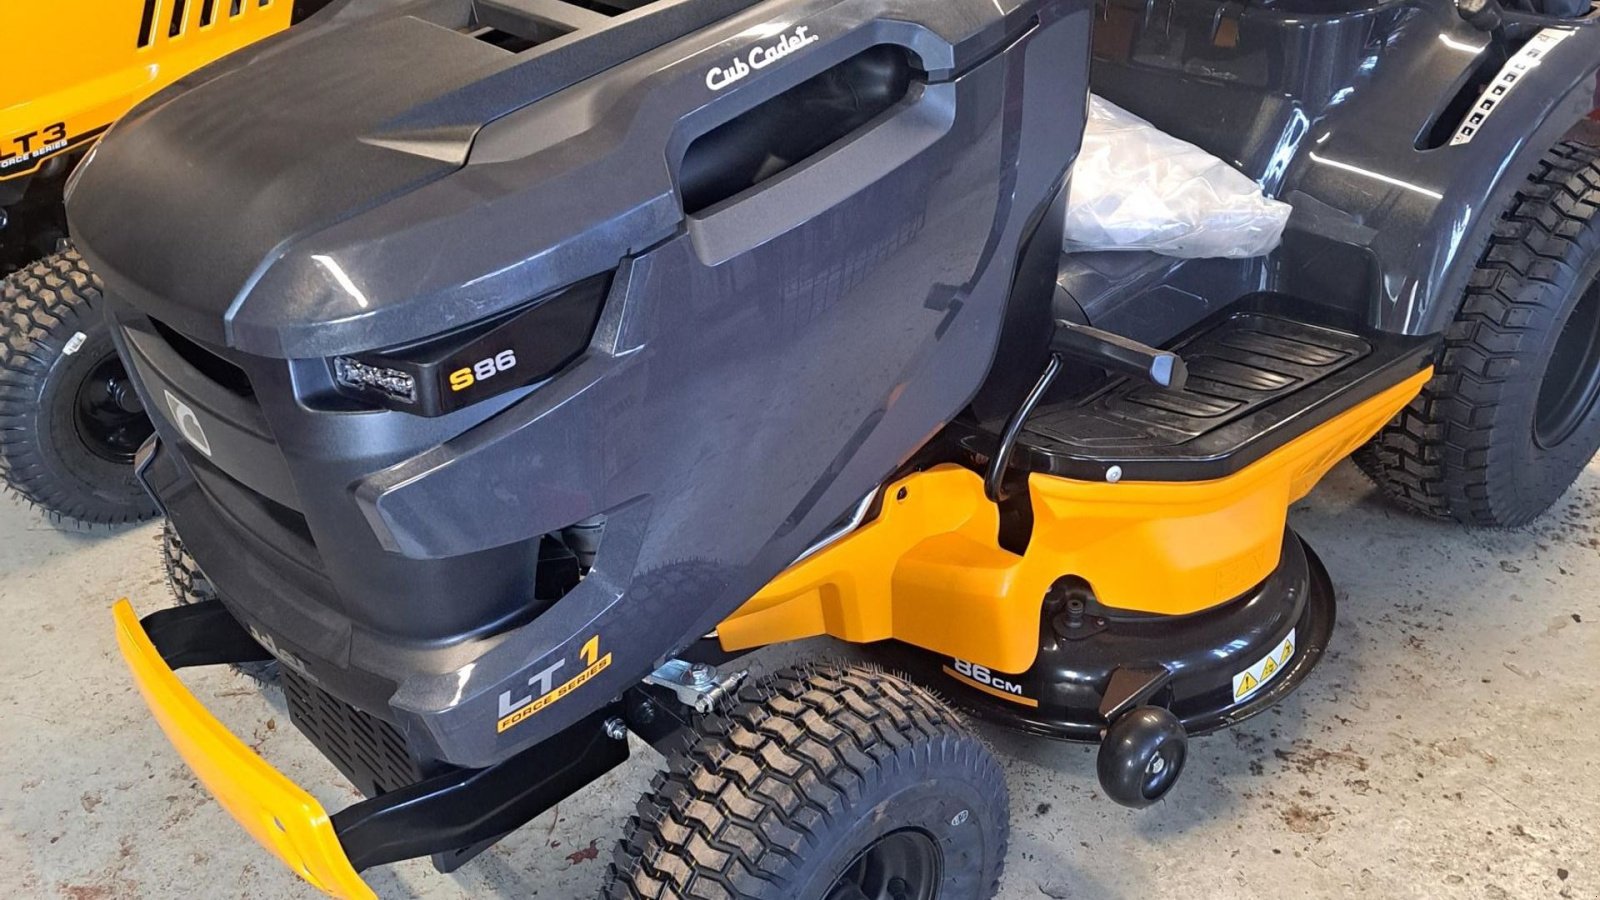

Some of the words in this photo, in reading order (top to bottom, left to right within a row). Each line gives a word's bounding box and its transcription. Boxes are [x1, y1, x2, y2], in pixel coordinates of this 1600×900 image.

[705, 56, 750, 91] Cub
[43, 121, 67, 145] 3
[0, 153, 30, 168] ORCE
[32, 139, 68, 158] SERIES
[449, 349, 517, 392] S86
[498, 657, 566, 719] LT
[579, 634, 599, 667] 1
[501, 695, 553, 729] FORCE
[558, 657, 608, 695] SERIES
